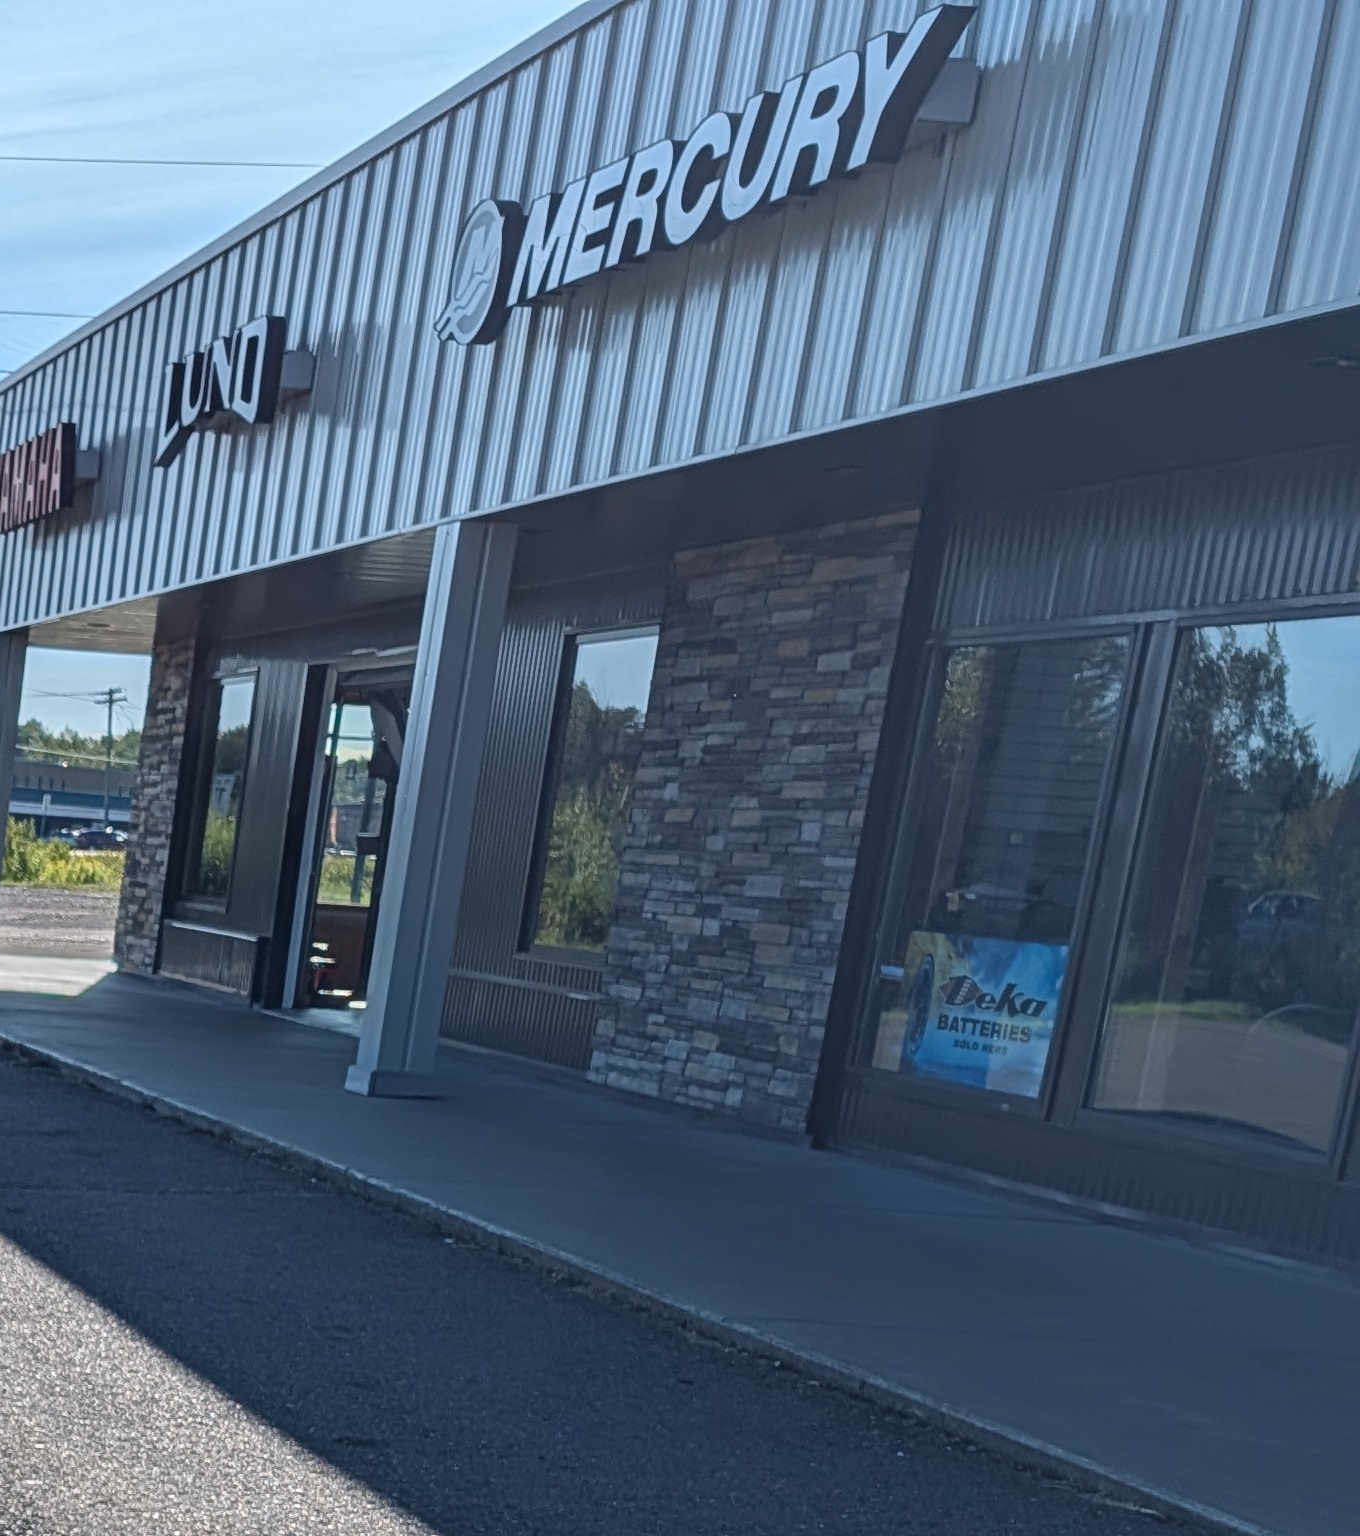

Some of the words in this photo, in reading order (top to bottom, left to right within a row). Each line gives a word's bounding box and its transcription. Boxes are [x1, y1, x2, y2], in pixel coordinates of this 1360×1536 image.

[507, 4, 950, 307] MERCURY
[154, 316, 270, 465] LUND
[937, 1014, 1032, 1044] BATTERIES
[939, 975, 1048, 1018] Deka
